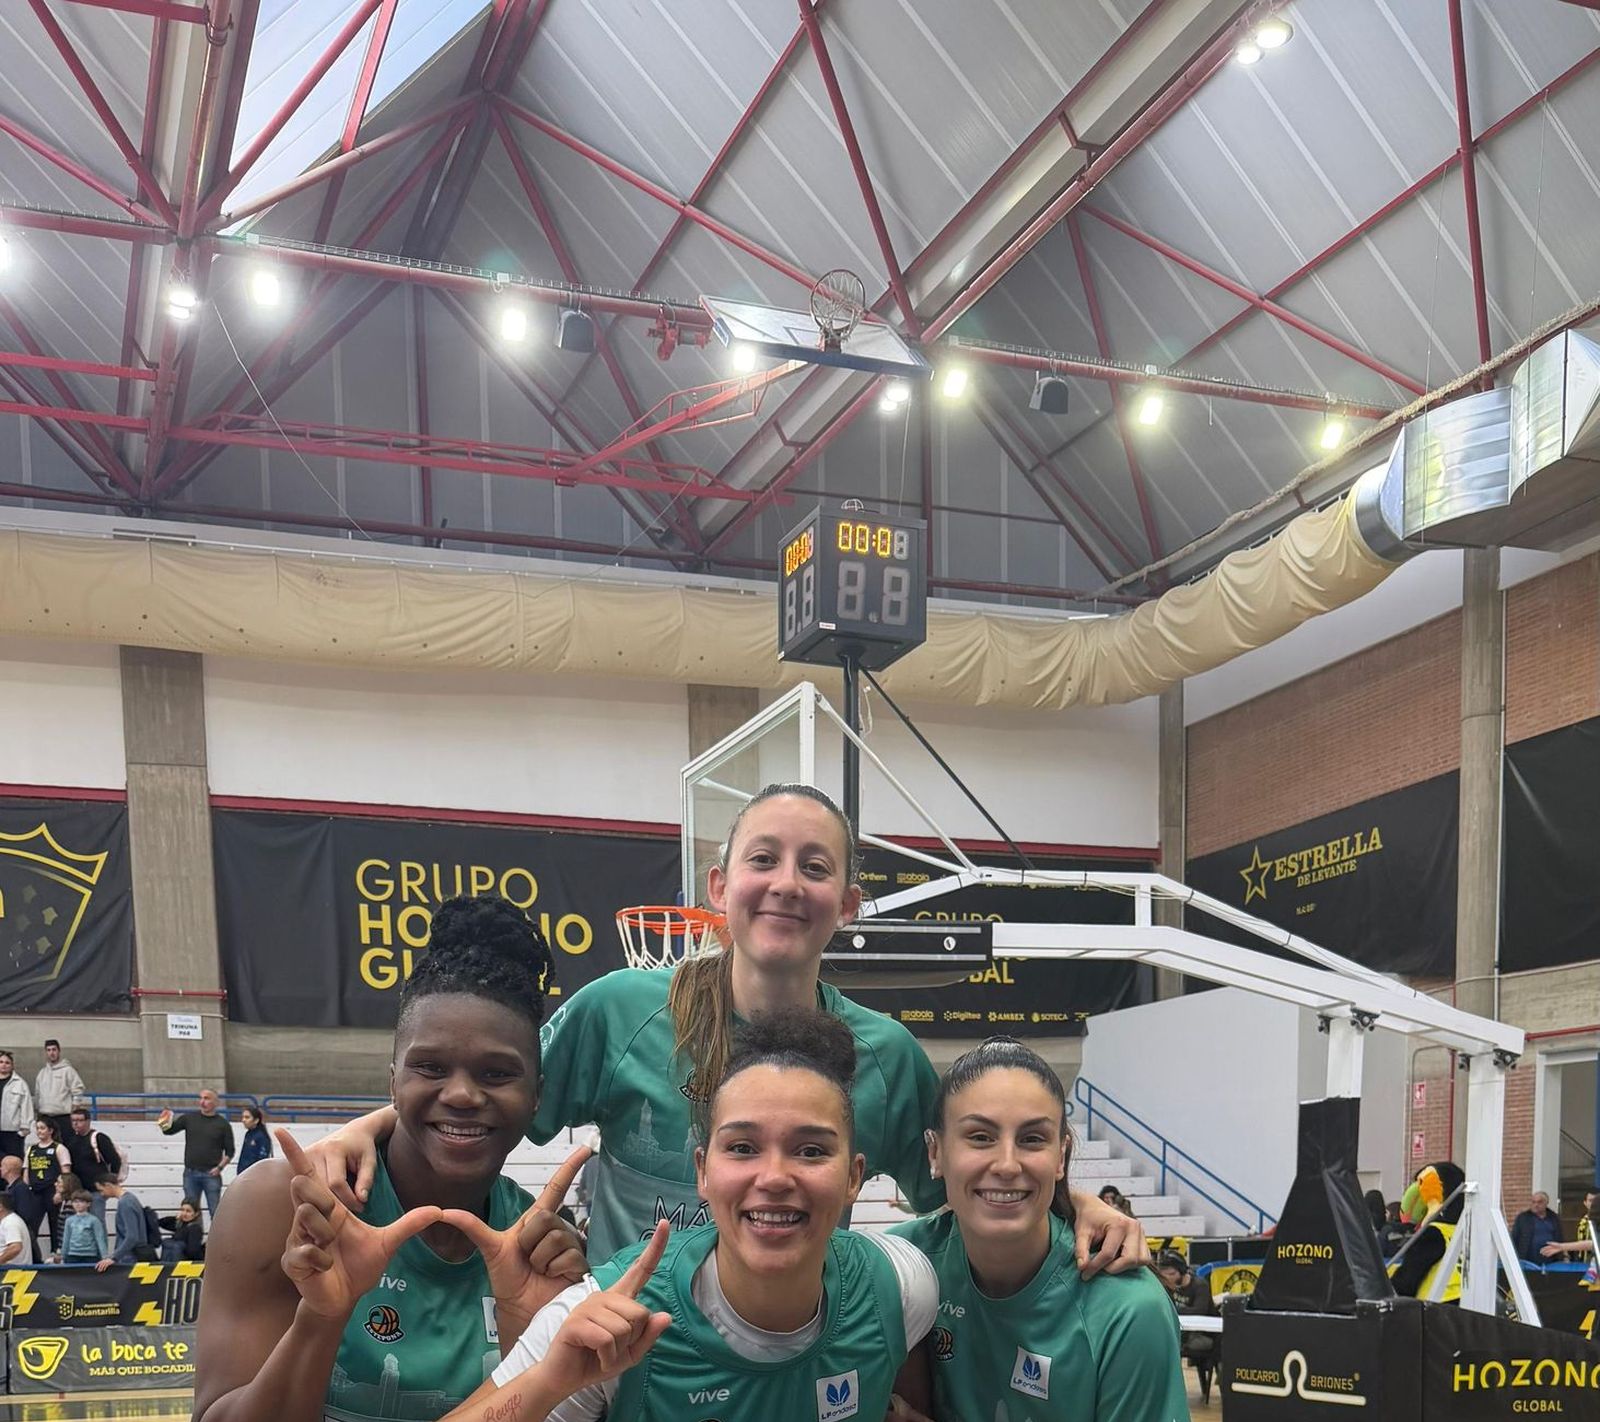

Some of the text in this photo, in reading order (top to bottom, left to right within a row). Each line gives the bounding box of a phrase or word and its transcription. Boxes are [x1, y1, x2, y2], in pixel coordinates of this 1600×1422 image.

[1274, 827, 1383, 882] ESTRELLA
[355, 858, 539, 909] GRUPO
[1297, 860, 1357, 888] DE LEVANTE
[1277, 1243, 1333, 1259] HOZONO
[378, 1273, 407, 1292] ive
[82, 1339, 189, 1364] la boca te
[144, 1363, 196, 1374] BOCADIL
[1236, 1367, 1280, 1384] POLICARPO
[688, 1386, 731, 1405] vive
[1512, 1399, 1563, 1413] GLOBAL
